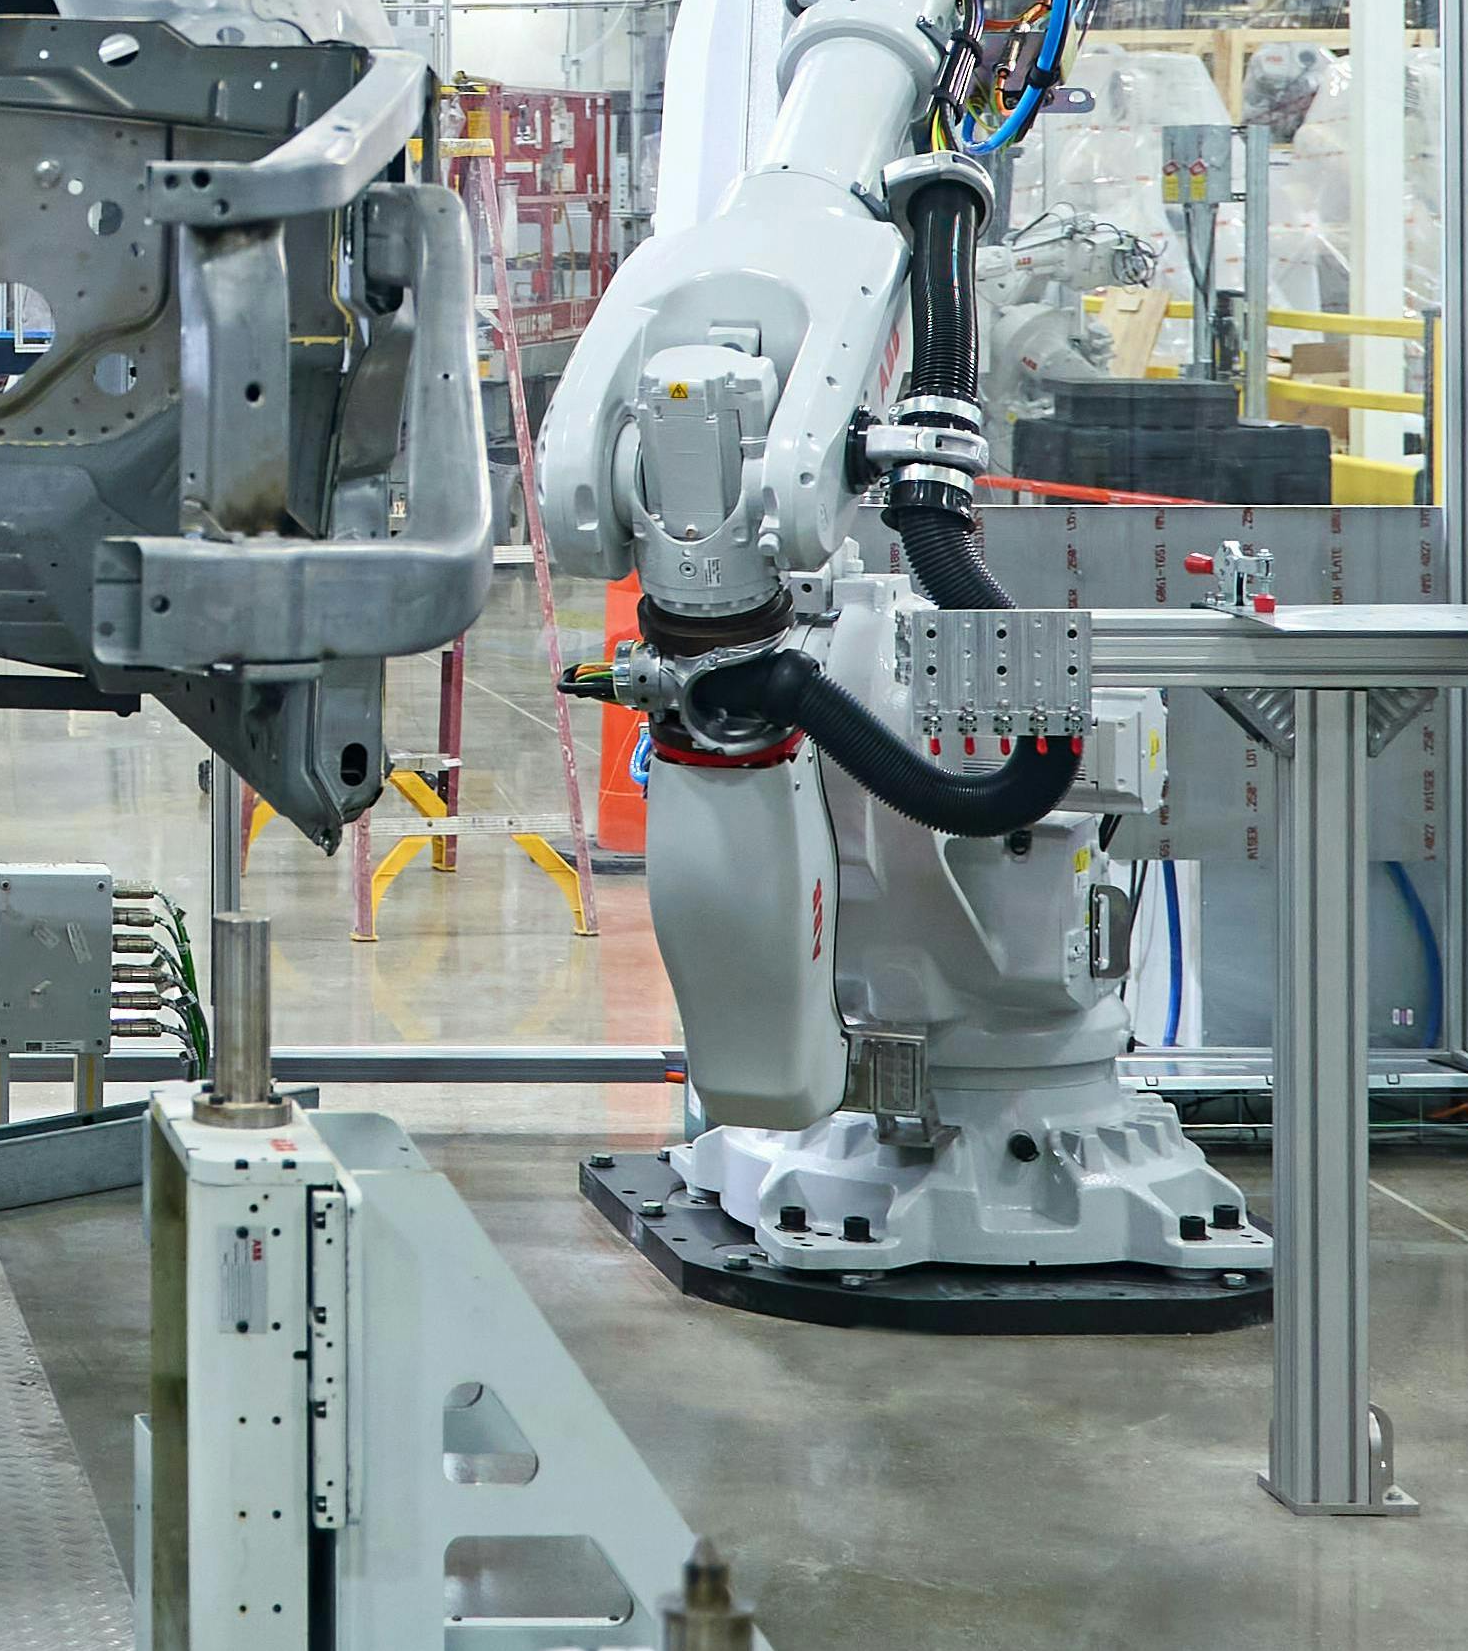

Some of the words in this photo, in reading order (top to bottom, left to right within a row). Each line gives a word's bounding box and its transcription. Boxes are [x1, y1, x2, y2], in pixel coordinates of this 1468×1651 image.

[878, 325, 900, 405] ABB
[1423, 769, 1435, 813] KAISER
[252, 1239, 262, 1262] ABB
